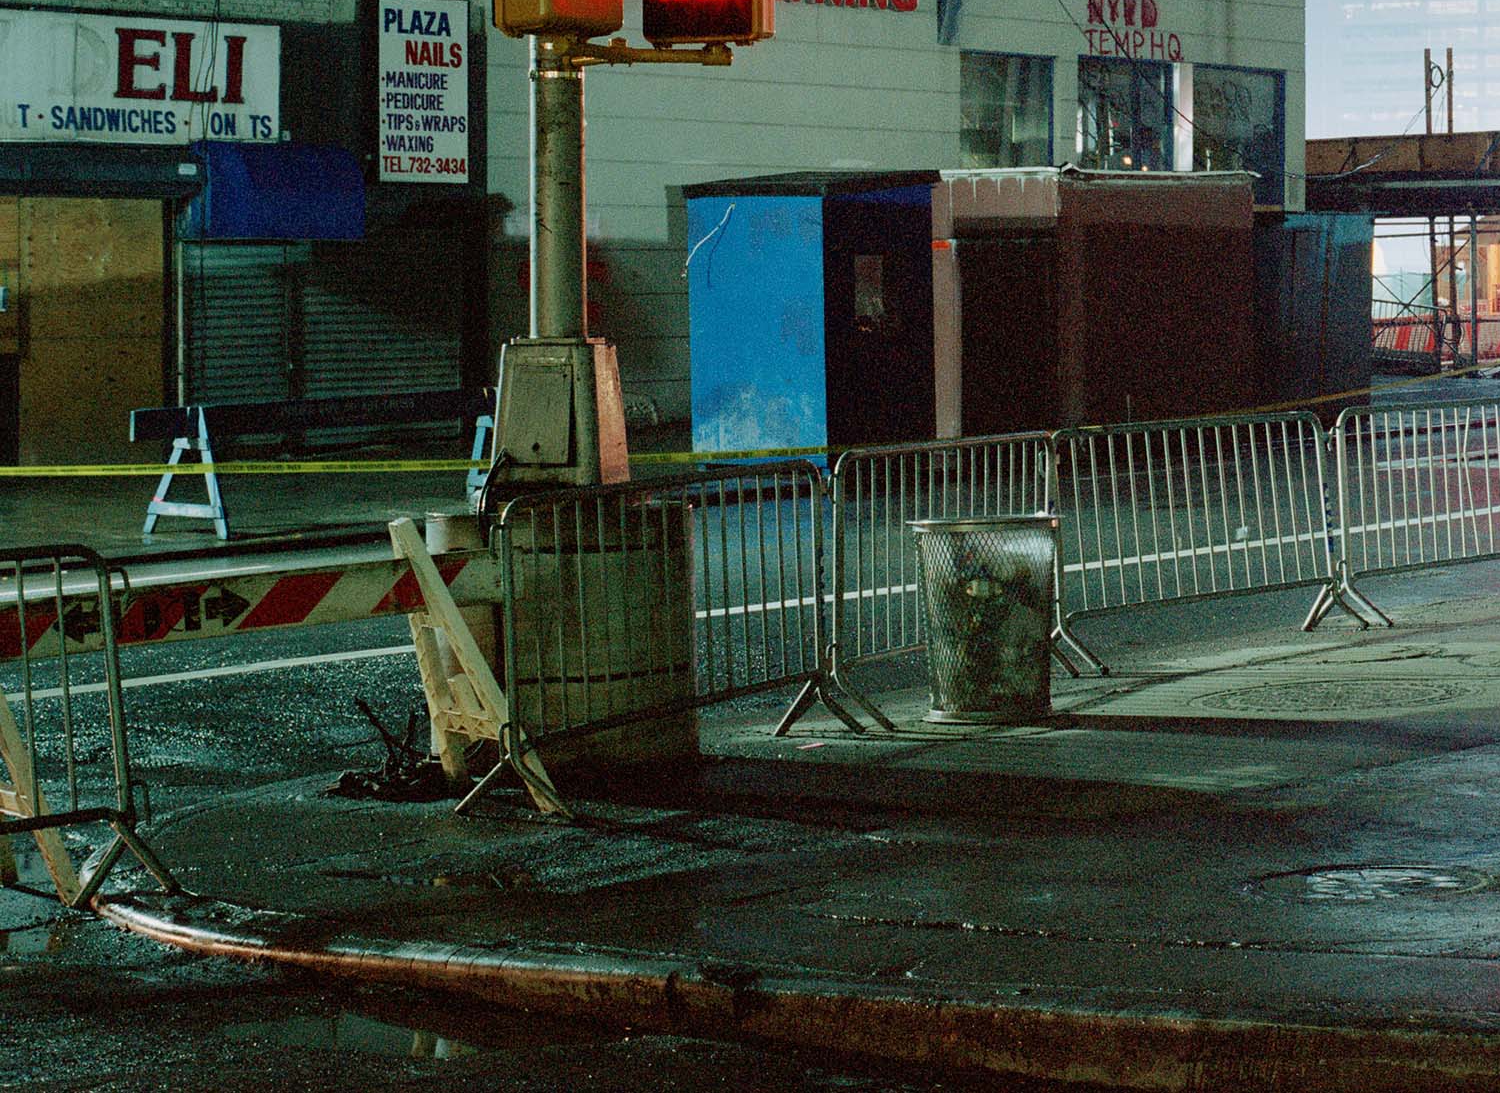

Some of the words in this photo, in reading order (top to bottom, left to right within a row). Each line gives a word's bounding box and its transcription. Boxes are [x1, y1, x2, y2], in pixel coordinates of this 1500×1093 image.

[384, 8, 452, 37] PLAZA
[405, 40, 463, 68] NAILS
[386, 70, 449, 90] MANICURE
[386, 92, 445, 111] PEDICURE
[51, 105, 177, 135] SANDWICHES
[386, 135, 434, 153] WAXING
